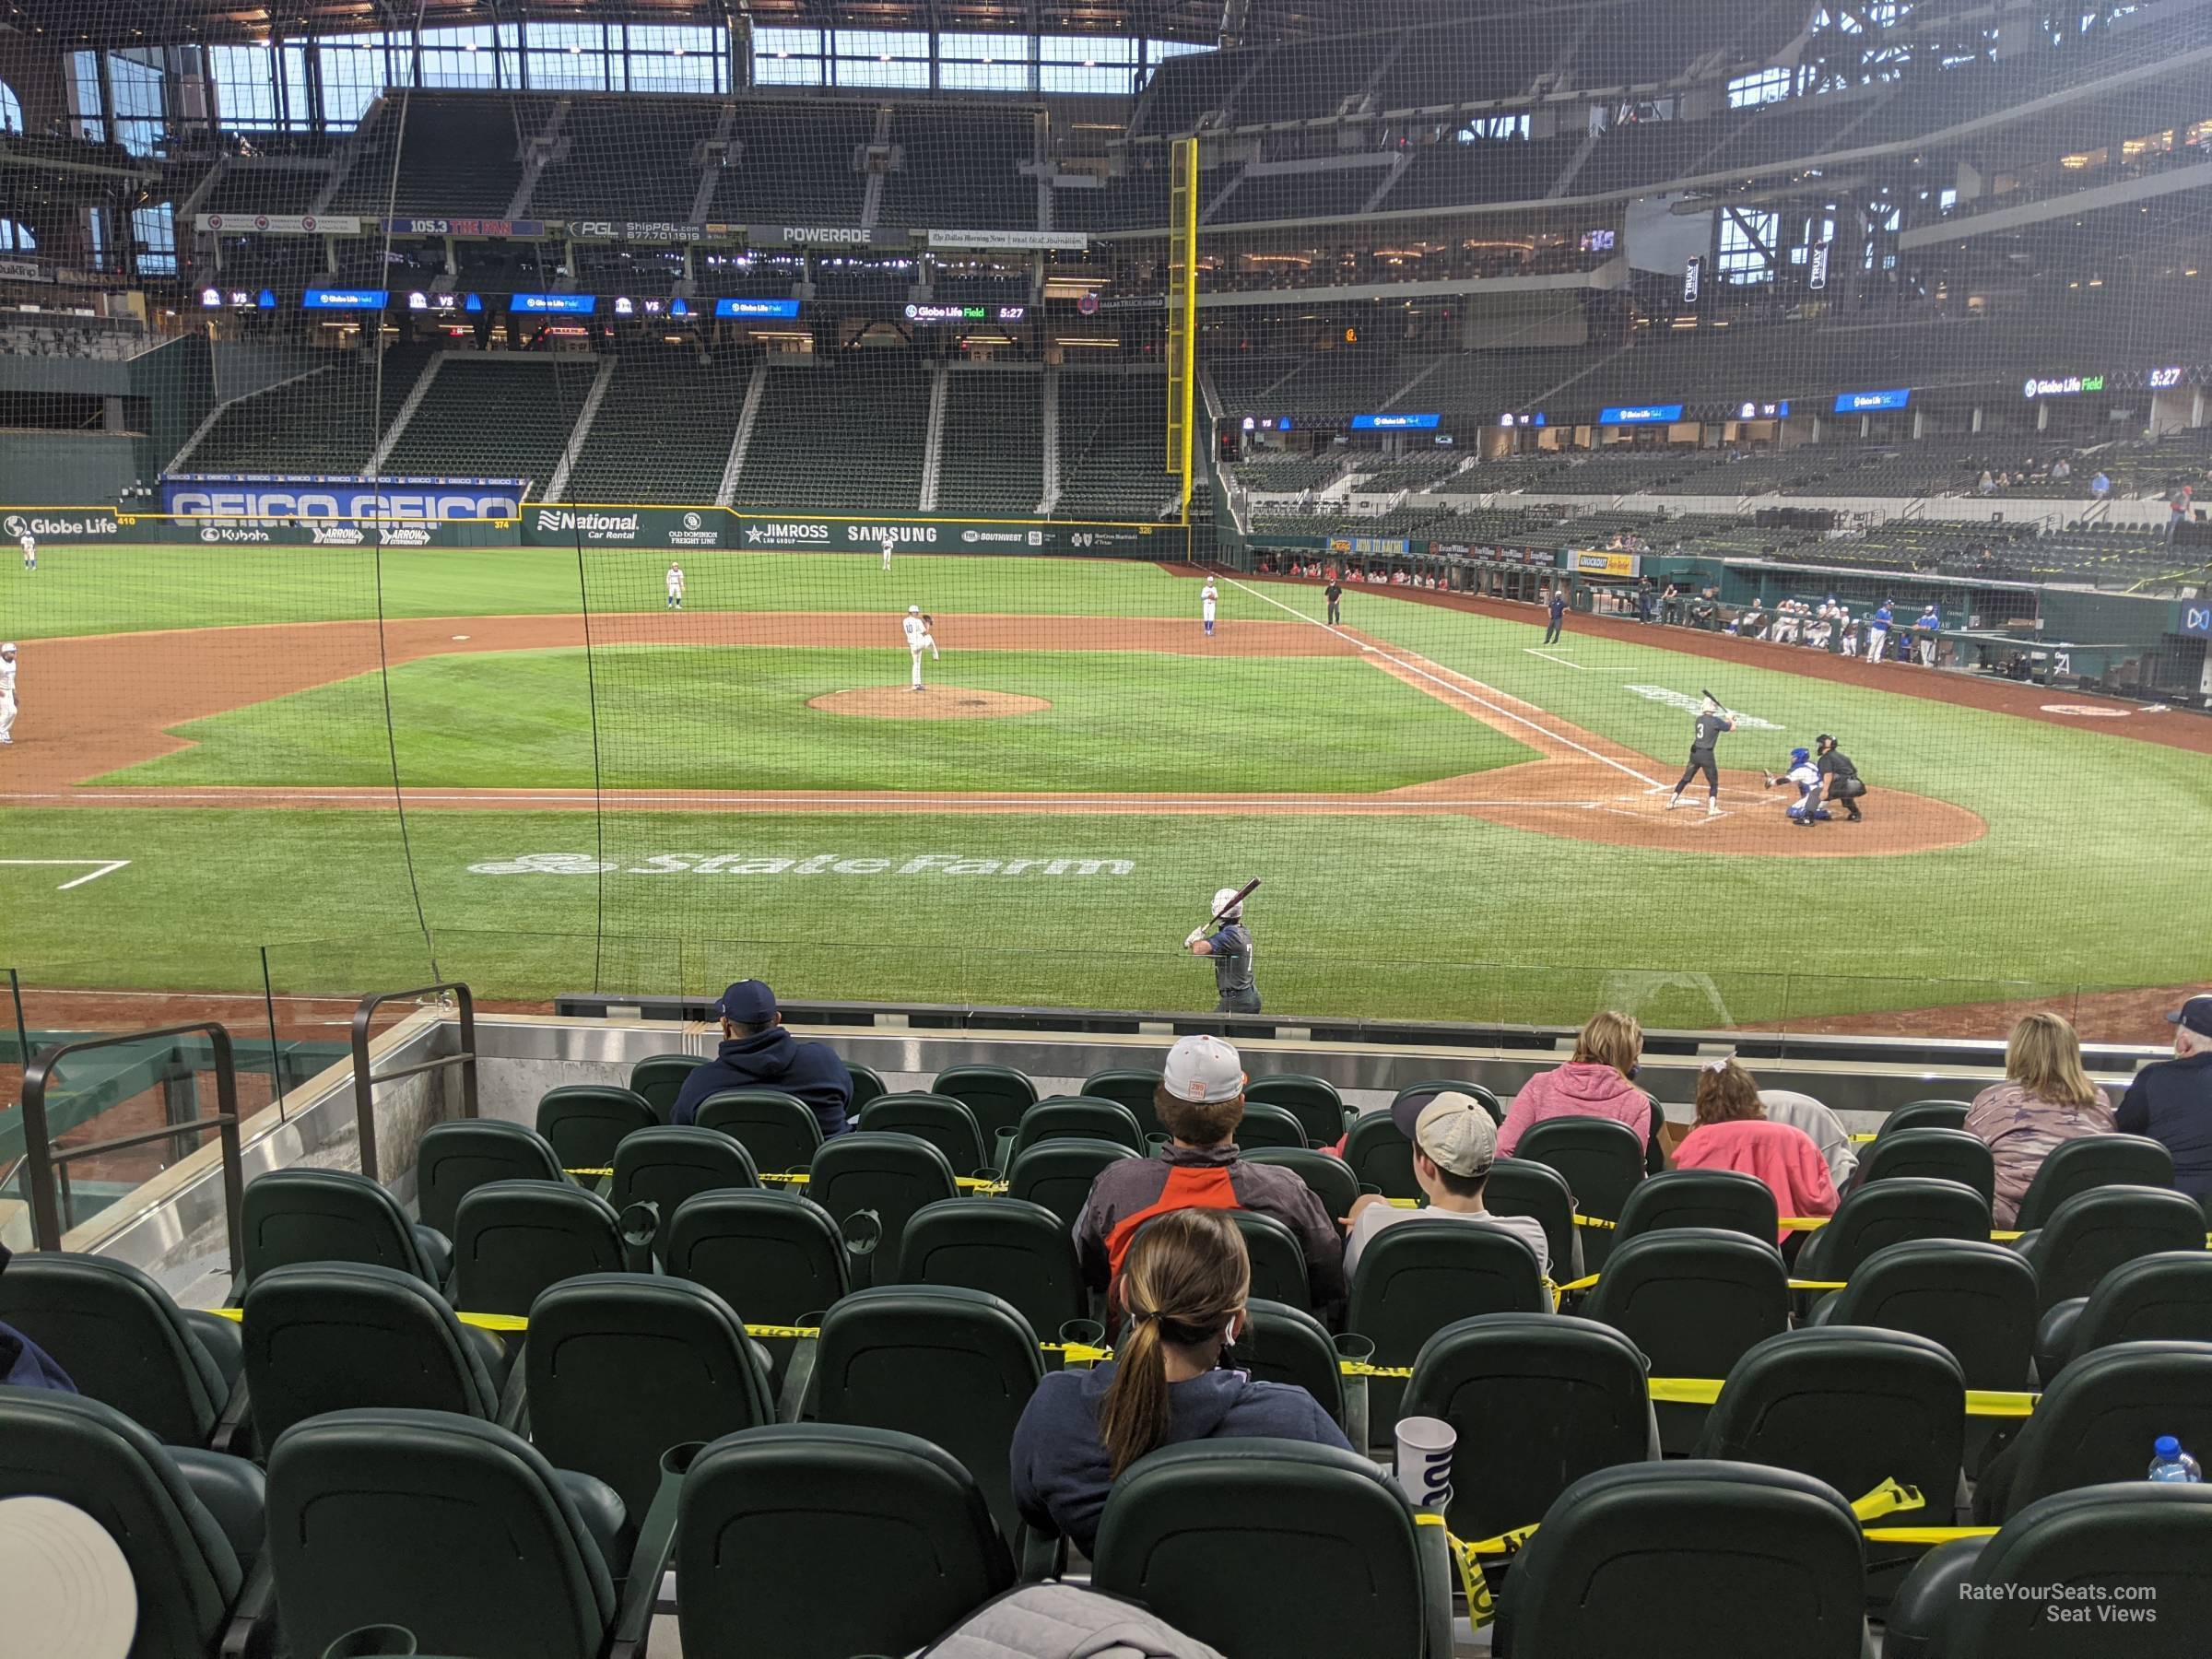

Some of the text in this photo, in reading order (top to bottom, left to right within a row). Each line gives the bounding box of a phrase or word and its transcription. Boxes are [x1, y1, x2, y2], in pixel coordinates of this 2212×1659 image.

[411, 219, 512, 234] 105.3 THE FAN
[582, 221, 618, 236] PGL
[627, 222, 700, 232] ShipPGL.com
[783, 228, 871, 242] POWERADE
[1813, 250, 1822, 280] TRULY
[1686, 265, 1694, 295] TRULY
[233, 292, 246, 303] VS
[440, 296, 453, 306] VS
[645, 300, 659, 311] VS
[918, 307, 984, 317] Globe Life Field
[1000, 308, 1024, 318] 5:27
[2150, 370, 2182, 386] 5:27
[2037, 376, 2103, 394] Globe Life Field
[1764, 405, 1776, 414] VS
[1262, 418, 1272, 428] VS
[1520, 415, 1530, 423] VS
[172, 493, 518, 530] GEICO GEICO
[30, 518, 118, 535] Globe Life
[118, 517, 135, 525] 410
[221, 528, 269, 542] Kubota
[324, 528, 356, 539] ARROW
[392, 529, 422, 540] ARROW
[588, 531, 635, 540] Car Rental
[848, 525, 937, 543] SAMSUNG
[981, 533, 1023, 542] SOUTHWEST
[1696, 723, 1704, 739] 3
[629, 853, 1135, 875] State Farm
[1246, 943, 1253, 971] 7
